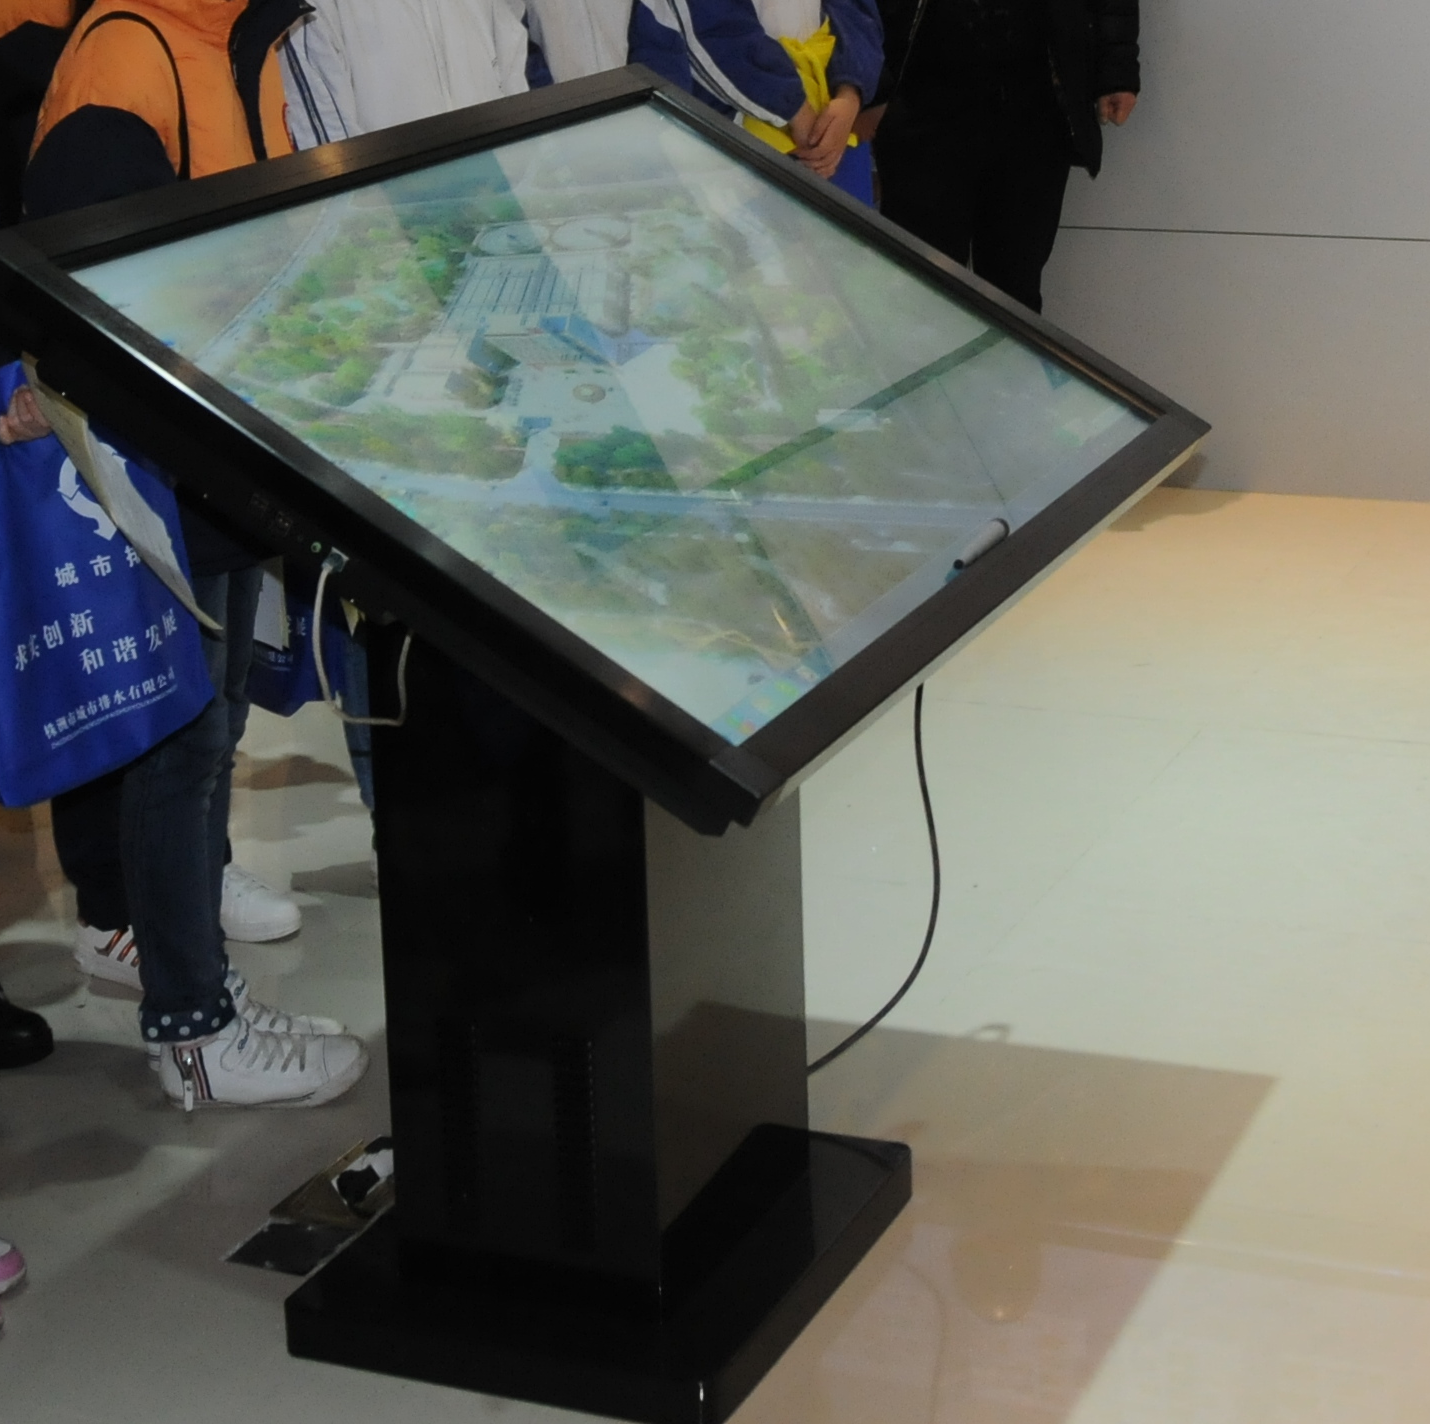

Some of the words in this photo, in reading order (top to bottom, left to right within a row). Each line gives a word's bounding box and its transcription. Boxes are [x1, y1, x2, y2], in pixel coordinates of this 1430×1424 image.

[15, 609, 94, 671] 求实创新
[79, 608, 178, 675] 和谐发展
